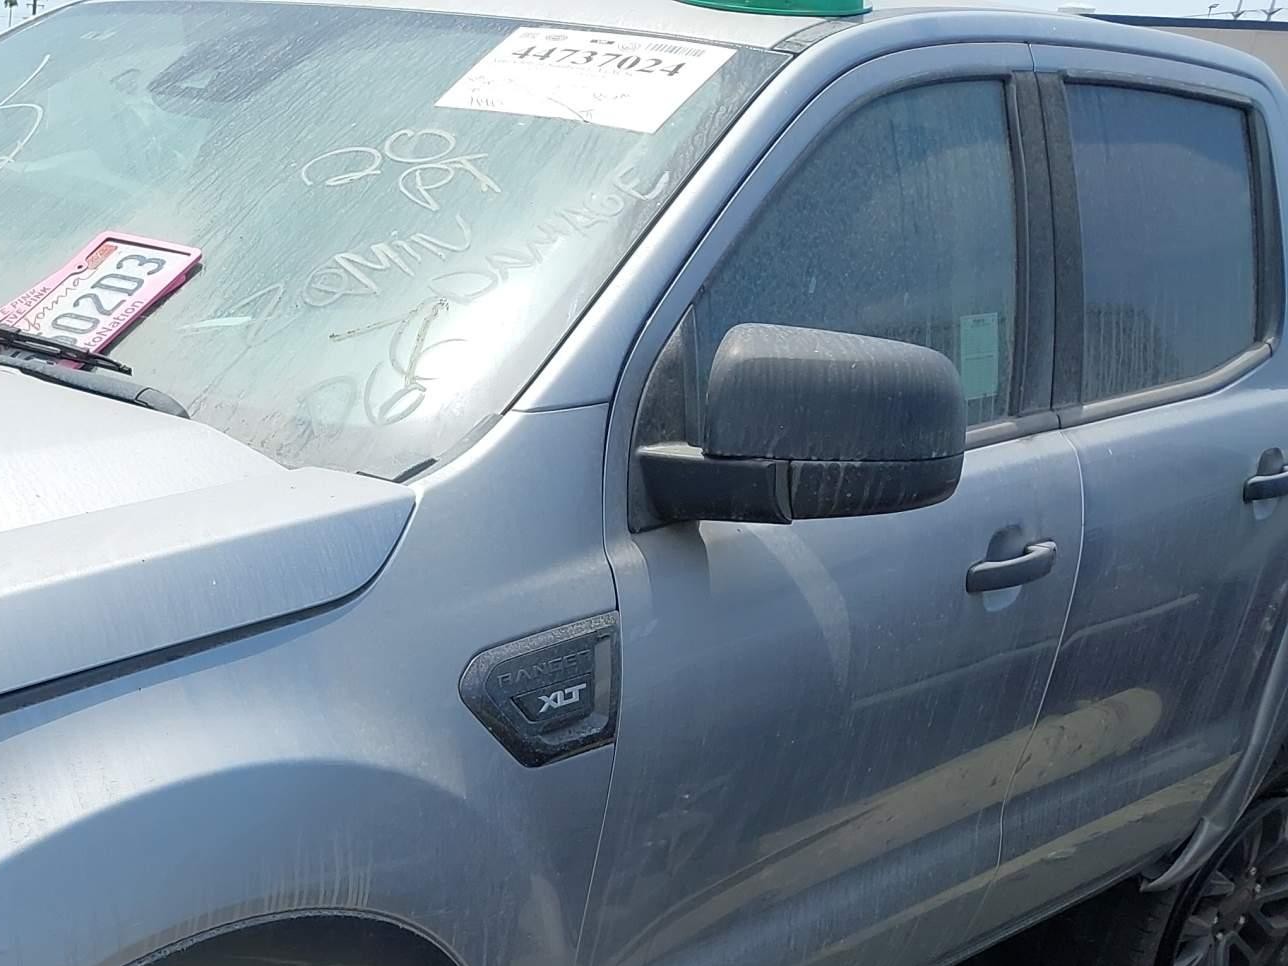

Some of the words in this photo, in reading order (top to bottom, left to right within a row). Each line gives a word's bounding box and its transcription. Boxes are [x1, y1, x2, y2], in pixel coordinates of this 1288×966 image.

[512, 44, 687, 78] 44737024
[23, 268, 98, 331] fornia
[24, 285, 52, 309] PINK
[34, 253, 167, 346] 02D3
[83, 299, 145, 349] toNation
[537, 682, 587, 714] XLT
